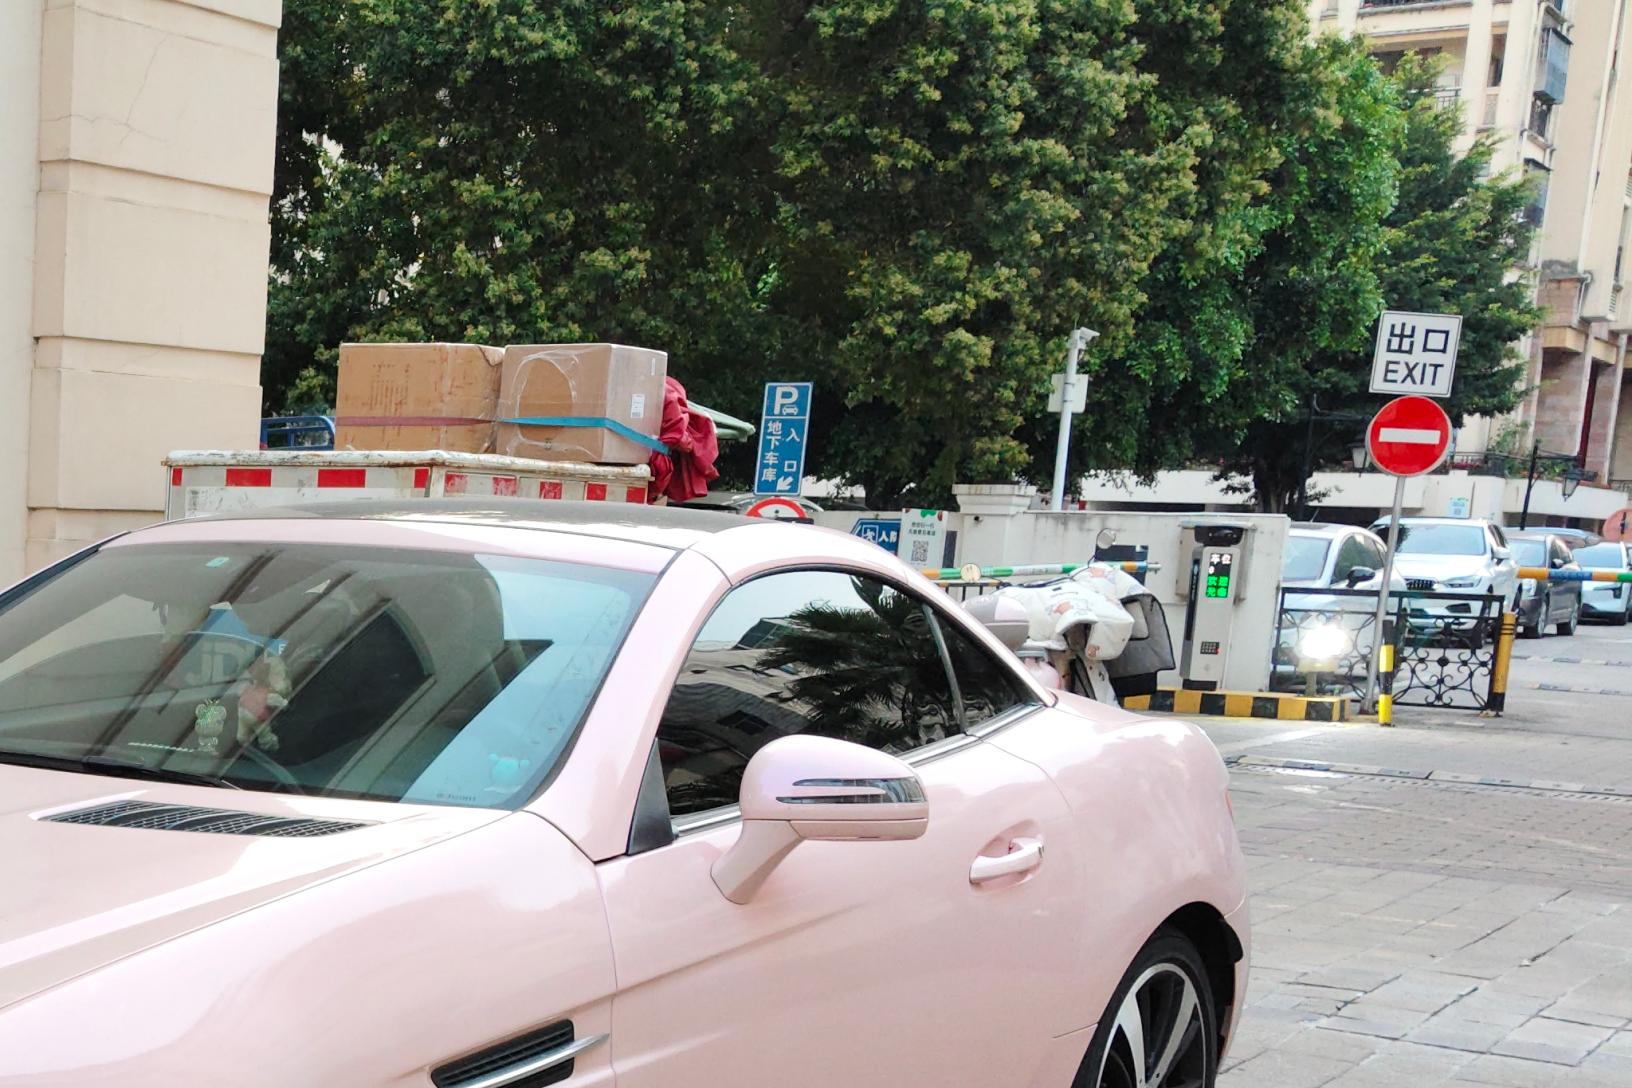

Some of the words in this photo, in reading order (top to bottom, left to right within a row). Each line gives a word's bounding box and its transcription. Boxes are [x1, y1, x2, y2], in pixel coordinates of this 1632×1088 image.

[1386, 321, 1450, 355] 出口
[1384, 360, 1444, 386] EXIT
[773, 386, 799, 415] P
[761, 420, 783, 482] 地下车库
[783, 427, 801, 473] 入口
